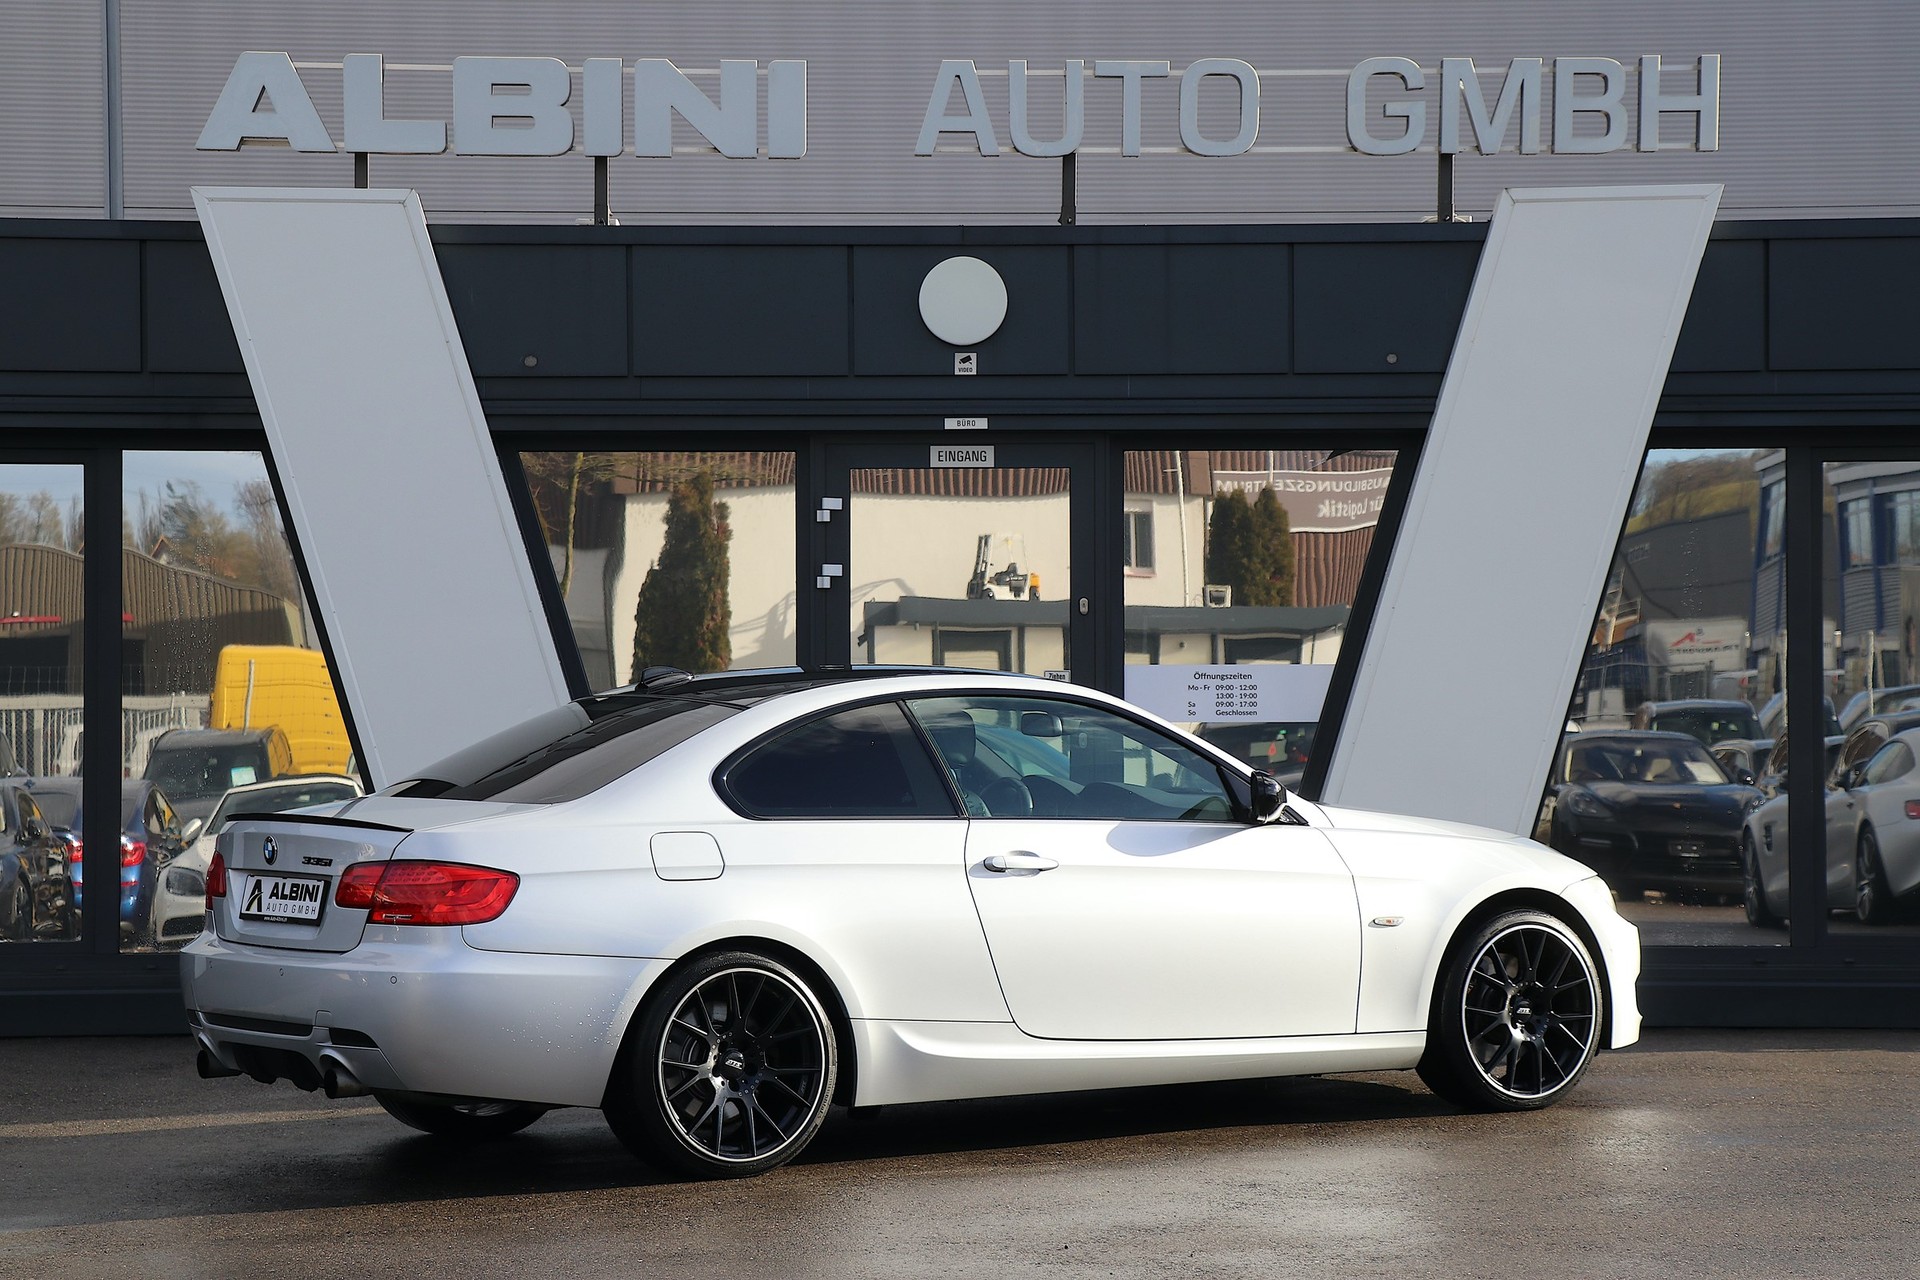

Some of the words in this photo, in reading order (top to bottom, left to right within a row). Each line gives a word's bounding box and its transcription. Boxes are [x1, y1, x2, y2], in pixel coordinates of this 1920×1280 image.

[194, 50, 808, 160] ALBINI
[914, 57, 1262, 157] AUTO
[1346, 53, 1721, 156] GMBH
[956, 419, 976, 427] BÜRO
[938, 450, 987, 462] EINGANG
[1194, 672, 1252, 681] Öffnungszeiten
[268, 882, 320, 902] ALBINI
[266, 903, 288, 913] AUTO
[291, 904, 316, 915] GMBH
